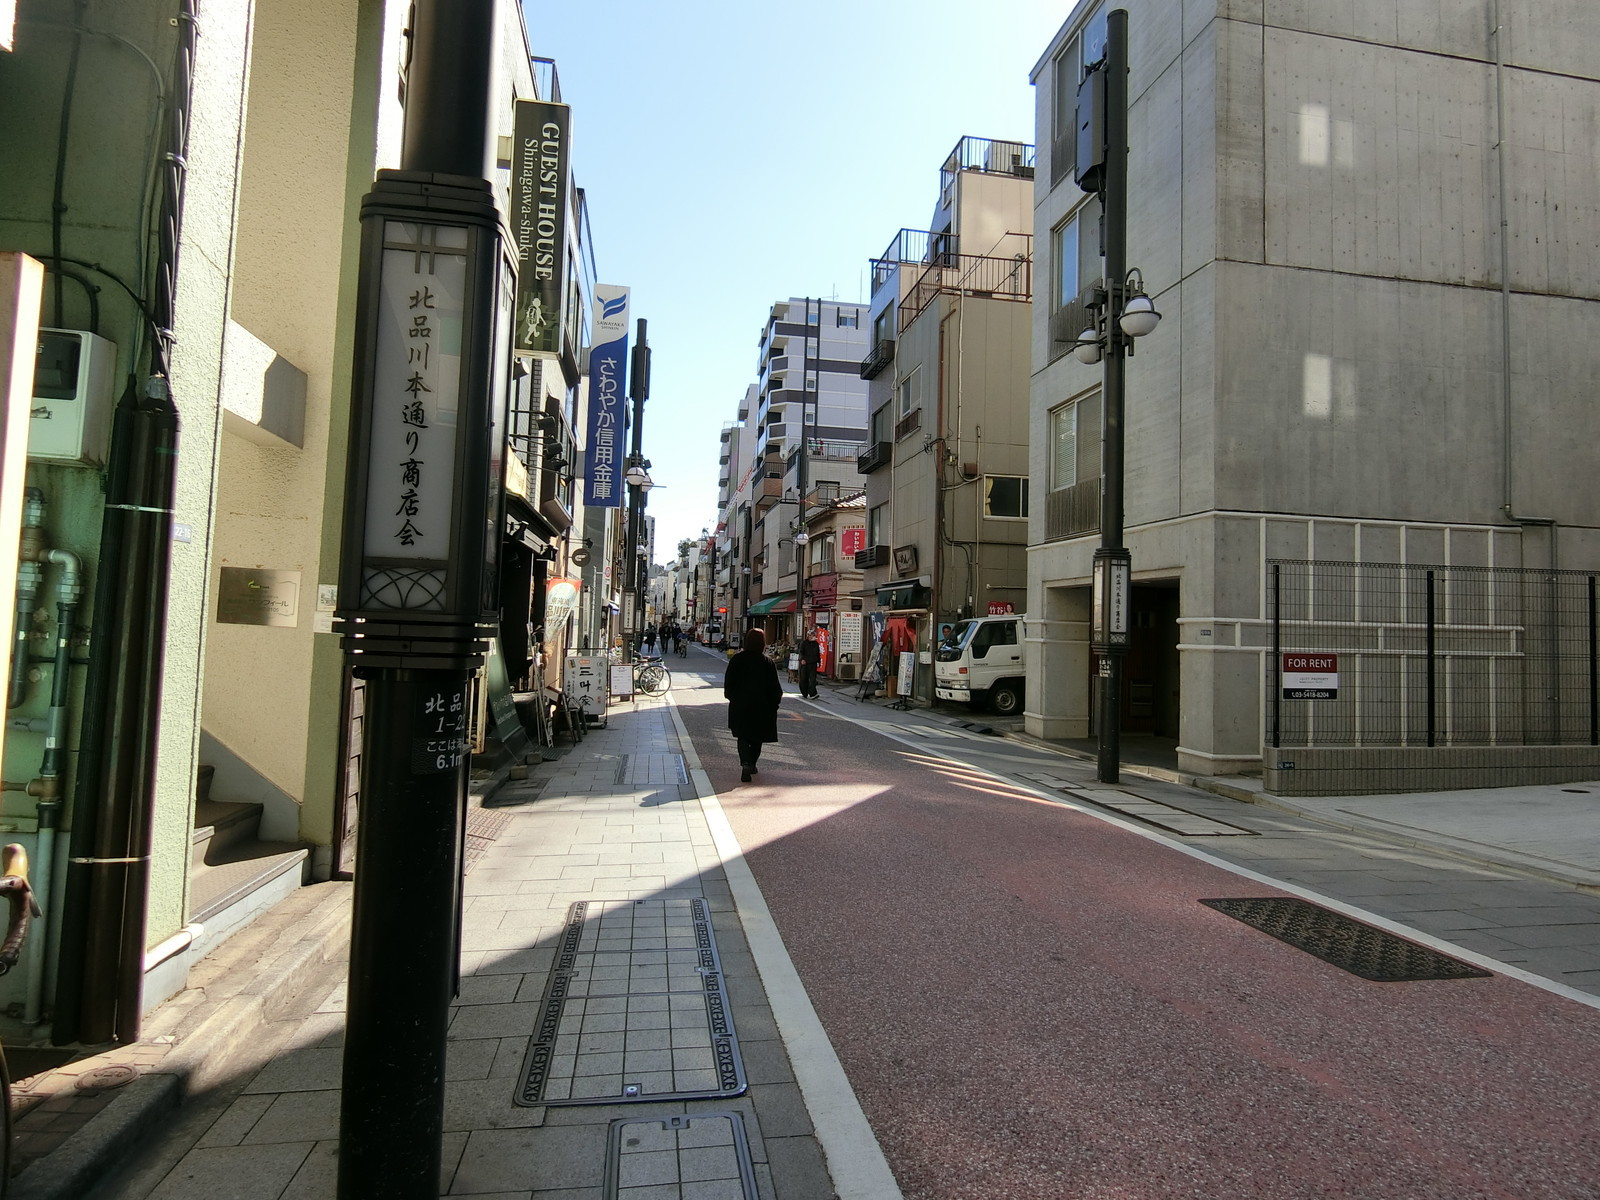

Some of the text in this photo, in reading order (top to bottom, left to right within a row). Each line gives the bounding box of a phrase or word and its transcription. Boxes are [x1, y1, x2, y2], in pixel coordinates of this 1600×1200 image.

[518, 138, 539, 262] Shinagawa-shuku
[534, 122, 560, 281] GUEST HOUSE
[597, 320, 625, 328] SAWAYAKA
[394, 285, 435, 546] 北品川本通り商店会
[592, 357, 618, 500] さわやか信用金庫
[1288, 658, 1333, 668] FOR RENT
